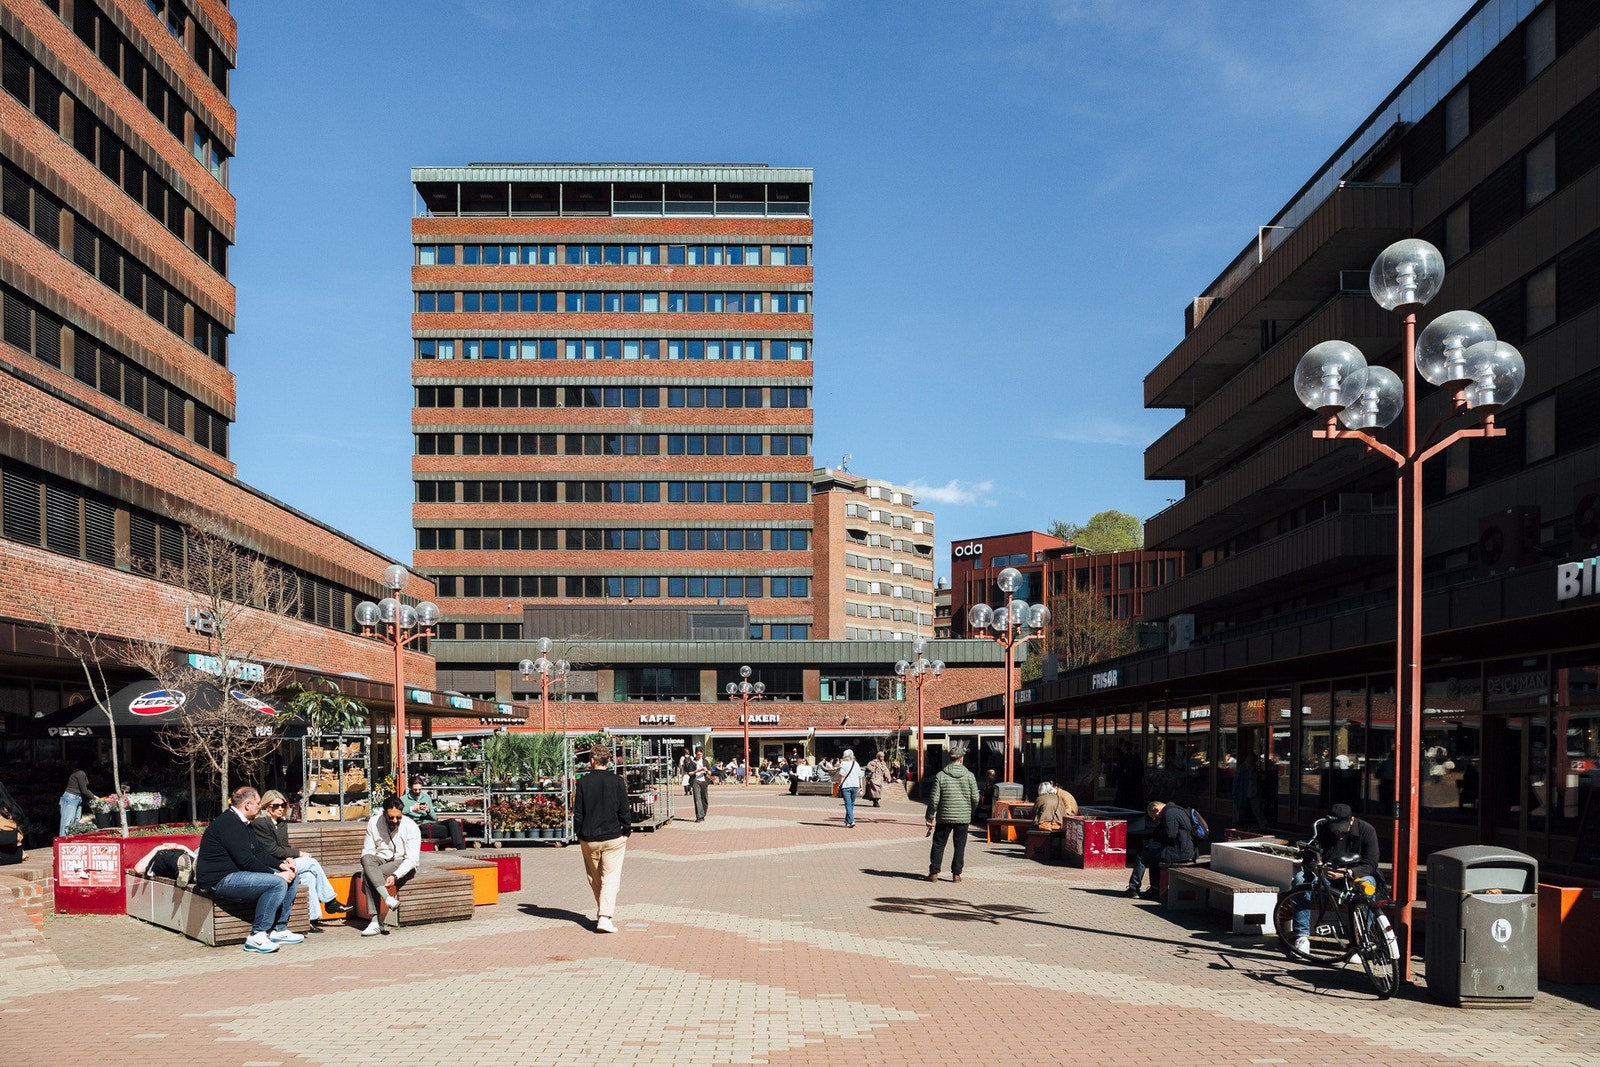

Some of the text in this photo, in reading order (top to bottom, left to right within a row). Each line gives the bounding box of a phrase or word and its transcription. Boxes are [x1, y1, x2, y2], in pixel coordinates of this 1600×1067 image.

[955, 541, 983, 557] oda
[1092, 669, 1118, 690] FRISØR
[1488, 672, 1545, 693] DEICHMAN
[640, 714, 676, 723] KAFFE
[48, 727, 92, 737] PEPSI
[61, 845, 87, 855] STOPP
[92, 846, 118, 855] STOPP
